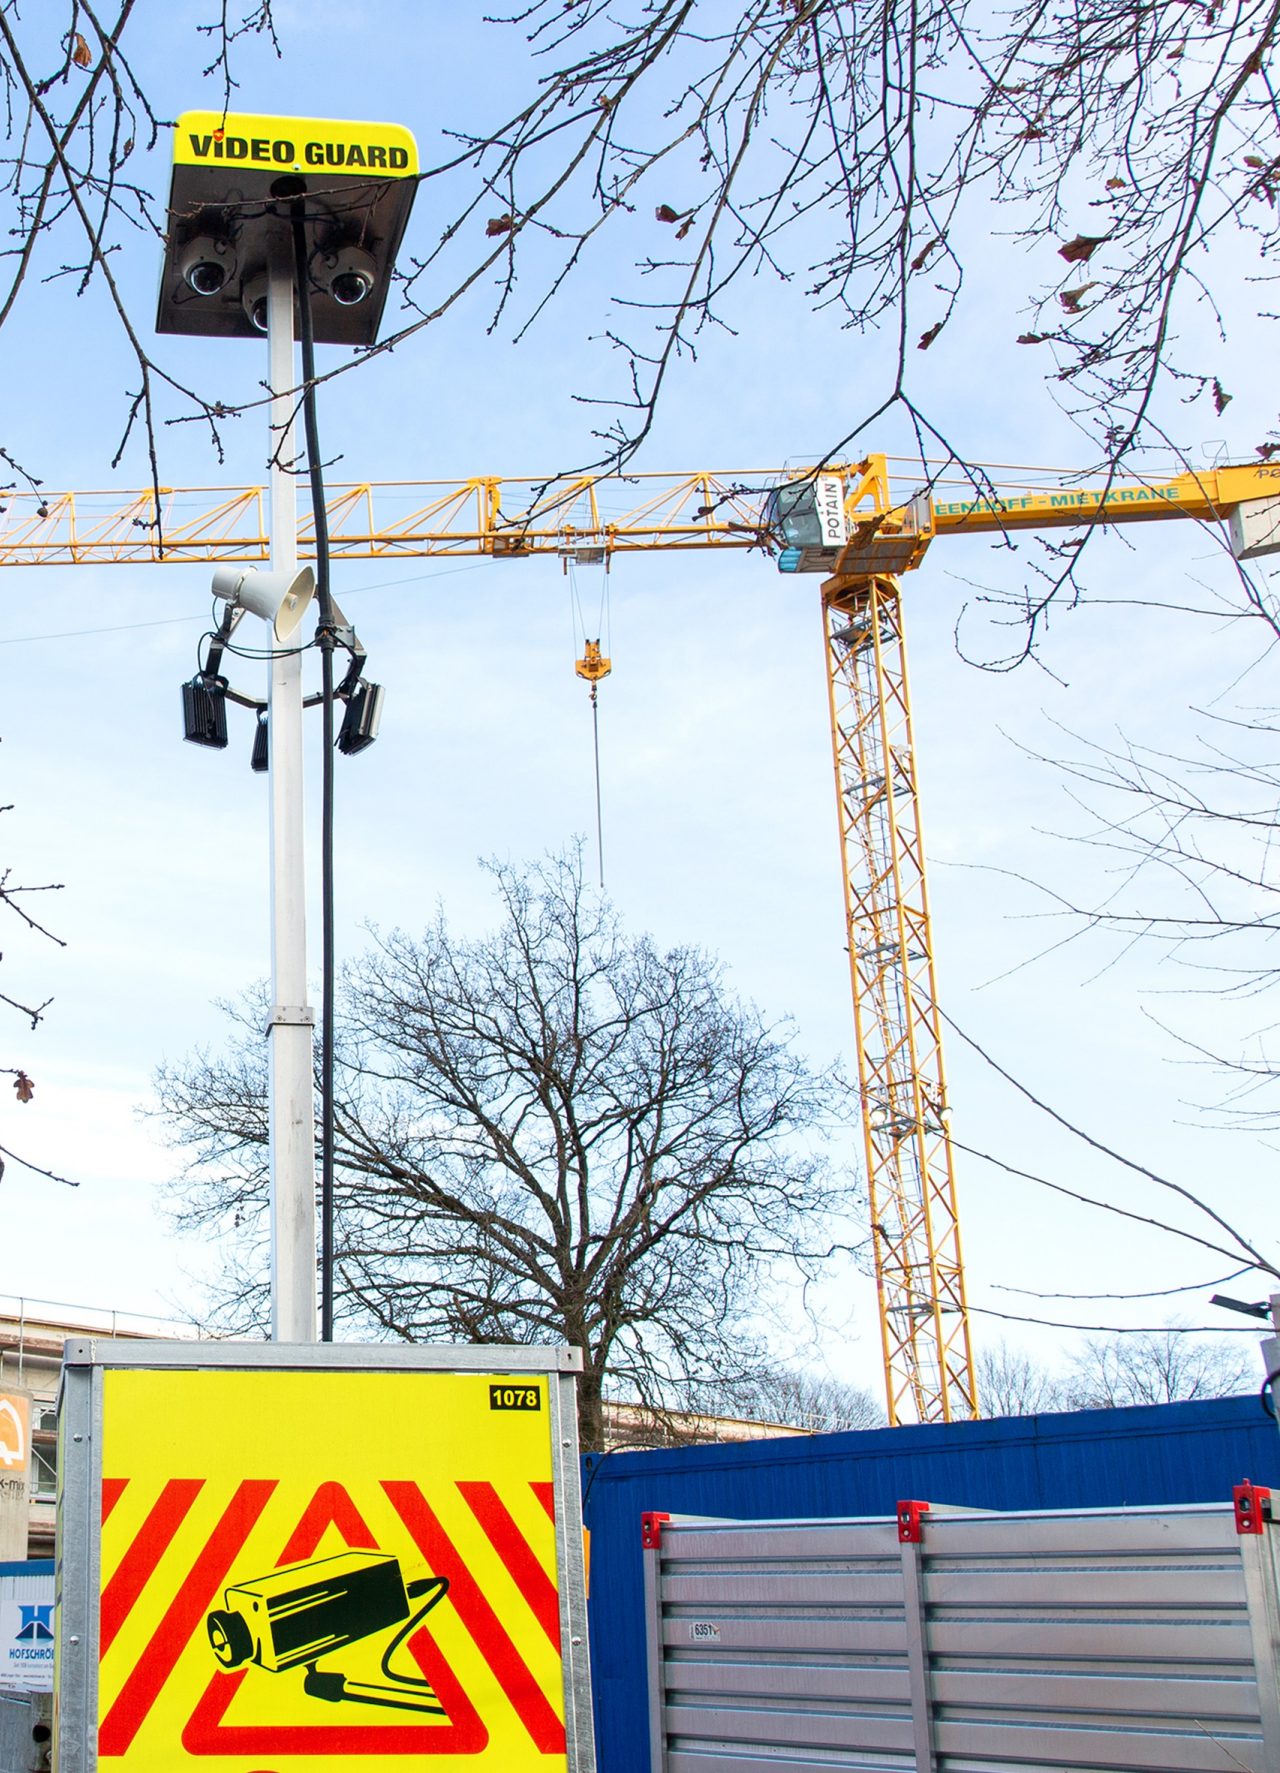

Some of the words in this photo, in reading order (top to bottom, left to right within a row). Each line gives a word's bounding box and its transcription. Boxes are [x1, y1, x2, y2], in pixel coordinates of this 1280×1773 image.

[189, 134, 295, 164] VIDEO
[305, 142, 409, 169] GUARD
[1050, 487, 1180, 507] MIETKRANE
[824, 483, 841, 539] POTAIN
[493, 1389, 538, 1407] 1078
